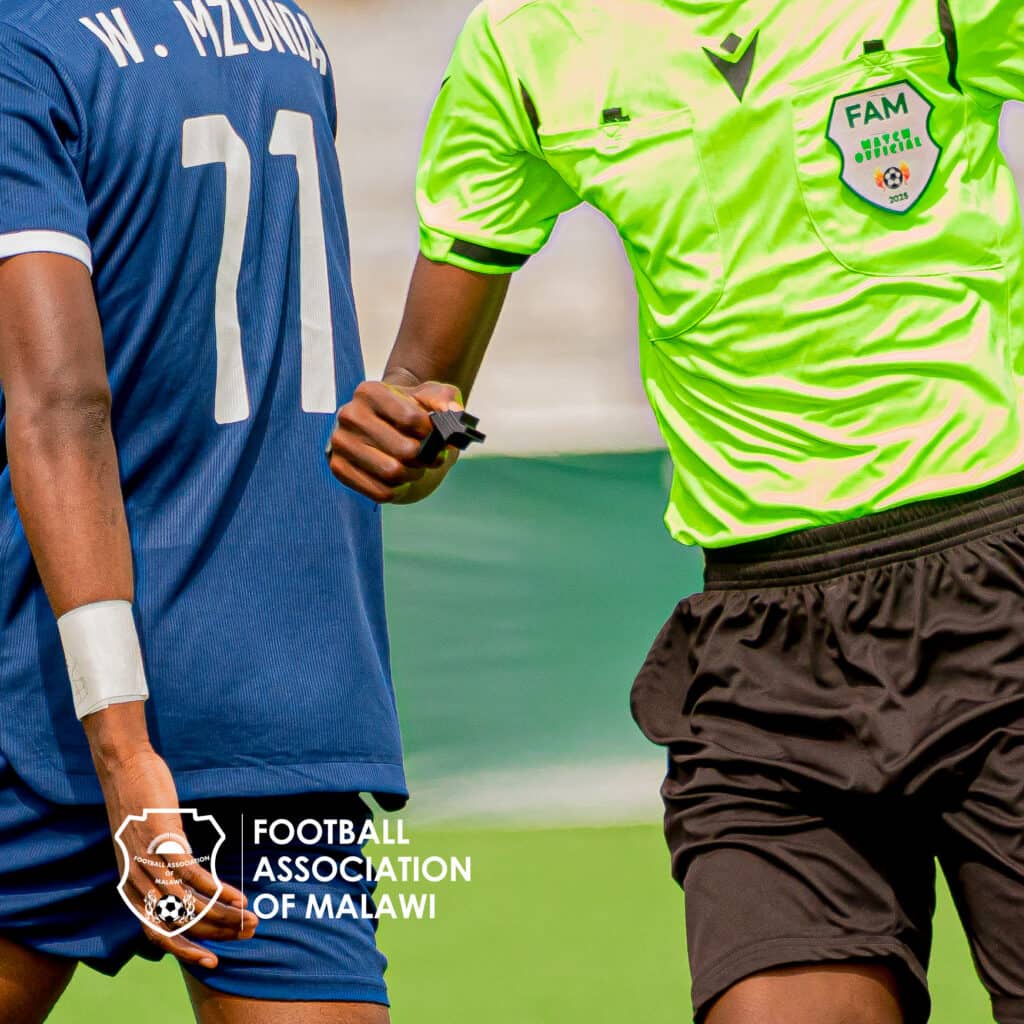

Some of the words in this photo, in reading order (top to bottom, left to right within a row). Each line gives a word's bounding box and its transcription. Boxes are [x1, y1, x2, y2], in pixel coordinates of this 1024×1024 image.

[845, 92, 908, 128] FAM
[854, 136, 922, 163] OFFICIAL
[861, 128, 911, 150] MATCH
